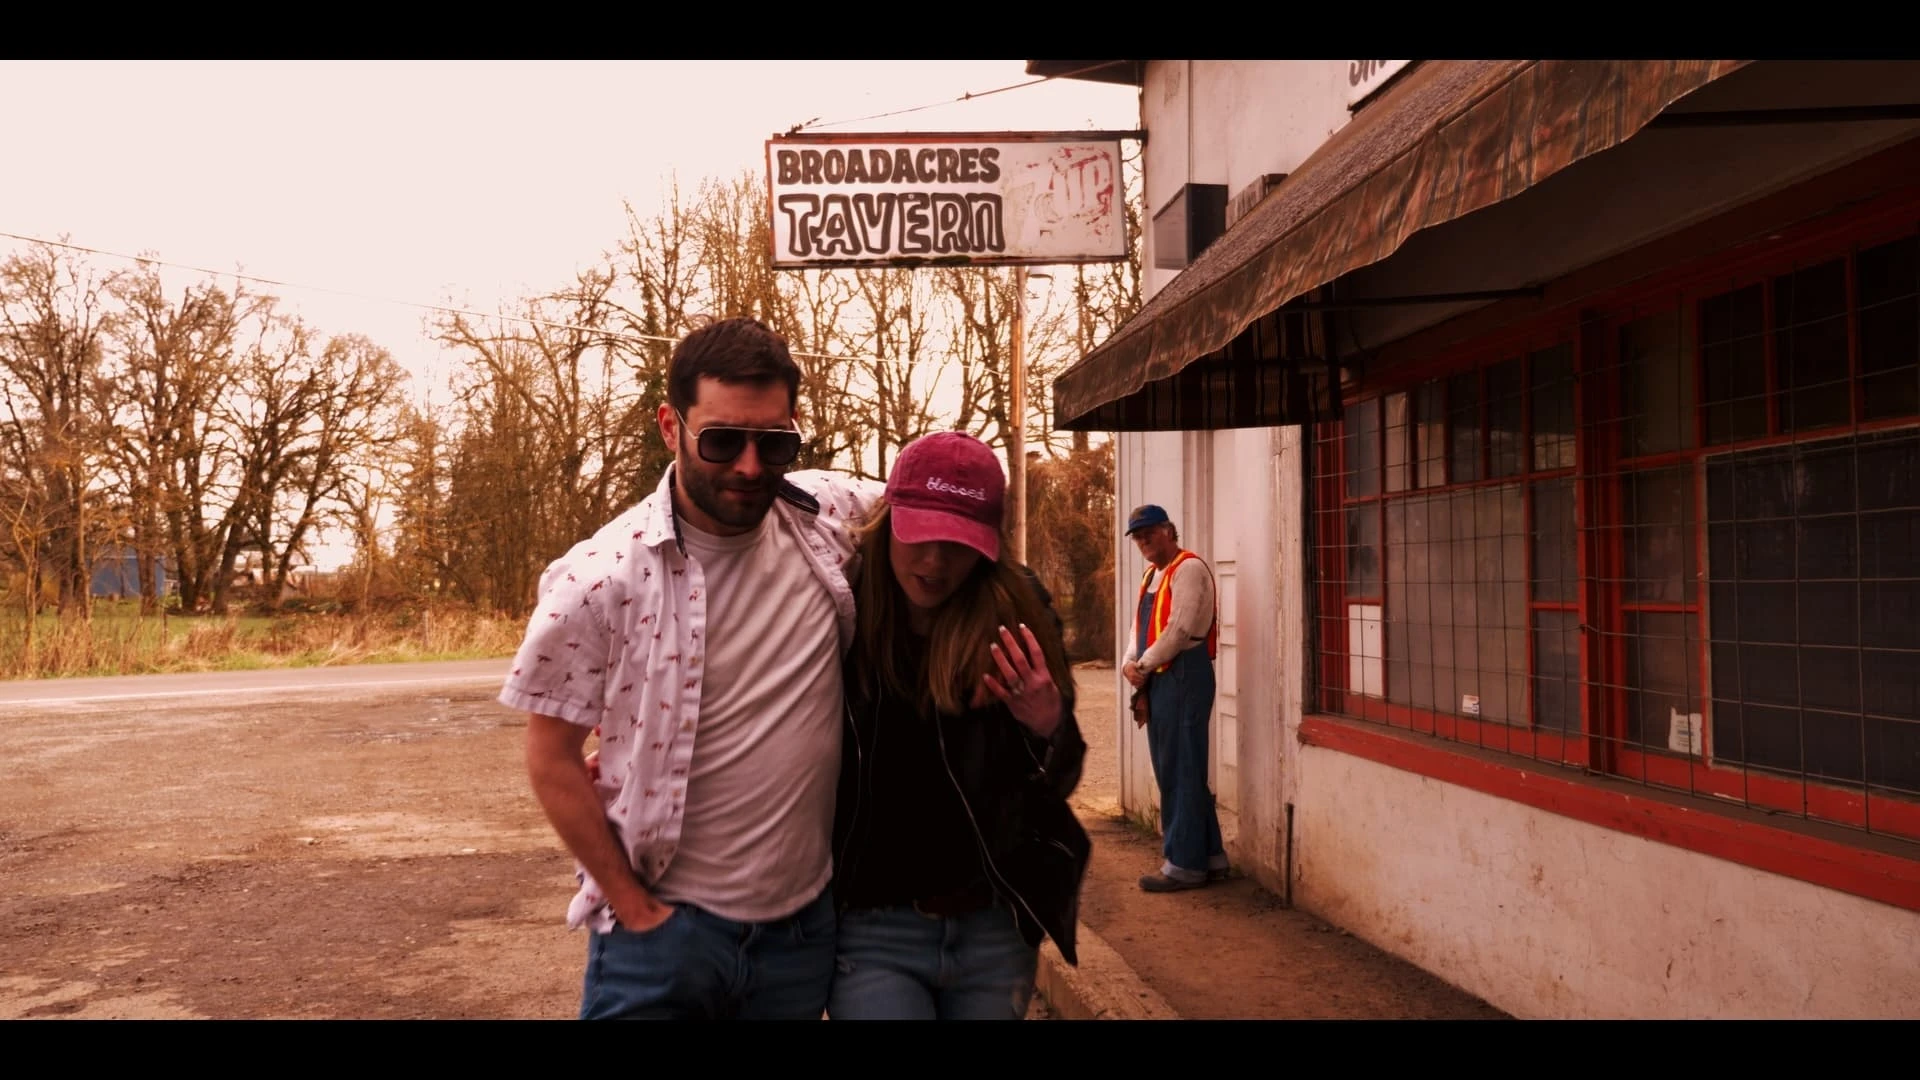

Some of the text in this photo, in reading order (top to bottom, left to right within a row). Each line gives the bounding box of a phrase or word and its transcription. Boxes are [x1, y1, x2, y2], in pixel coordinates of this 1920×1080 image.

[778, 148, 1001, 185] BROADACRES
[778, 193, 1006, 257] TAVERN
[926, 476, 986, 500] blessed
